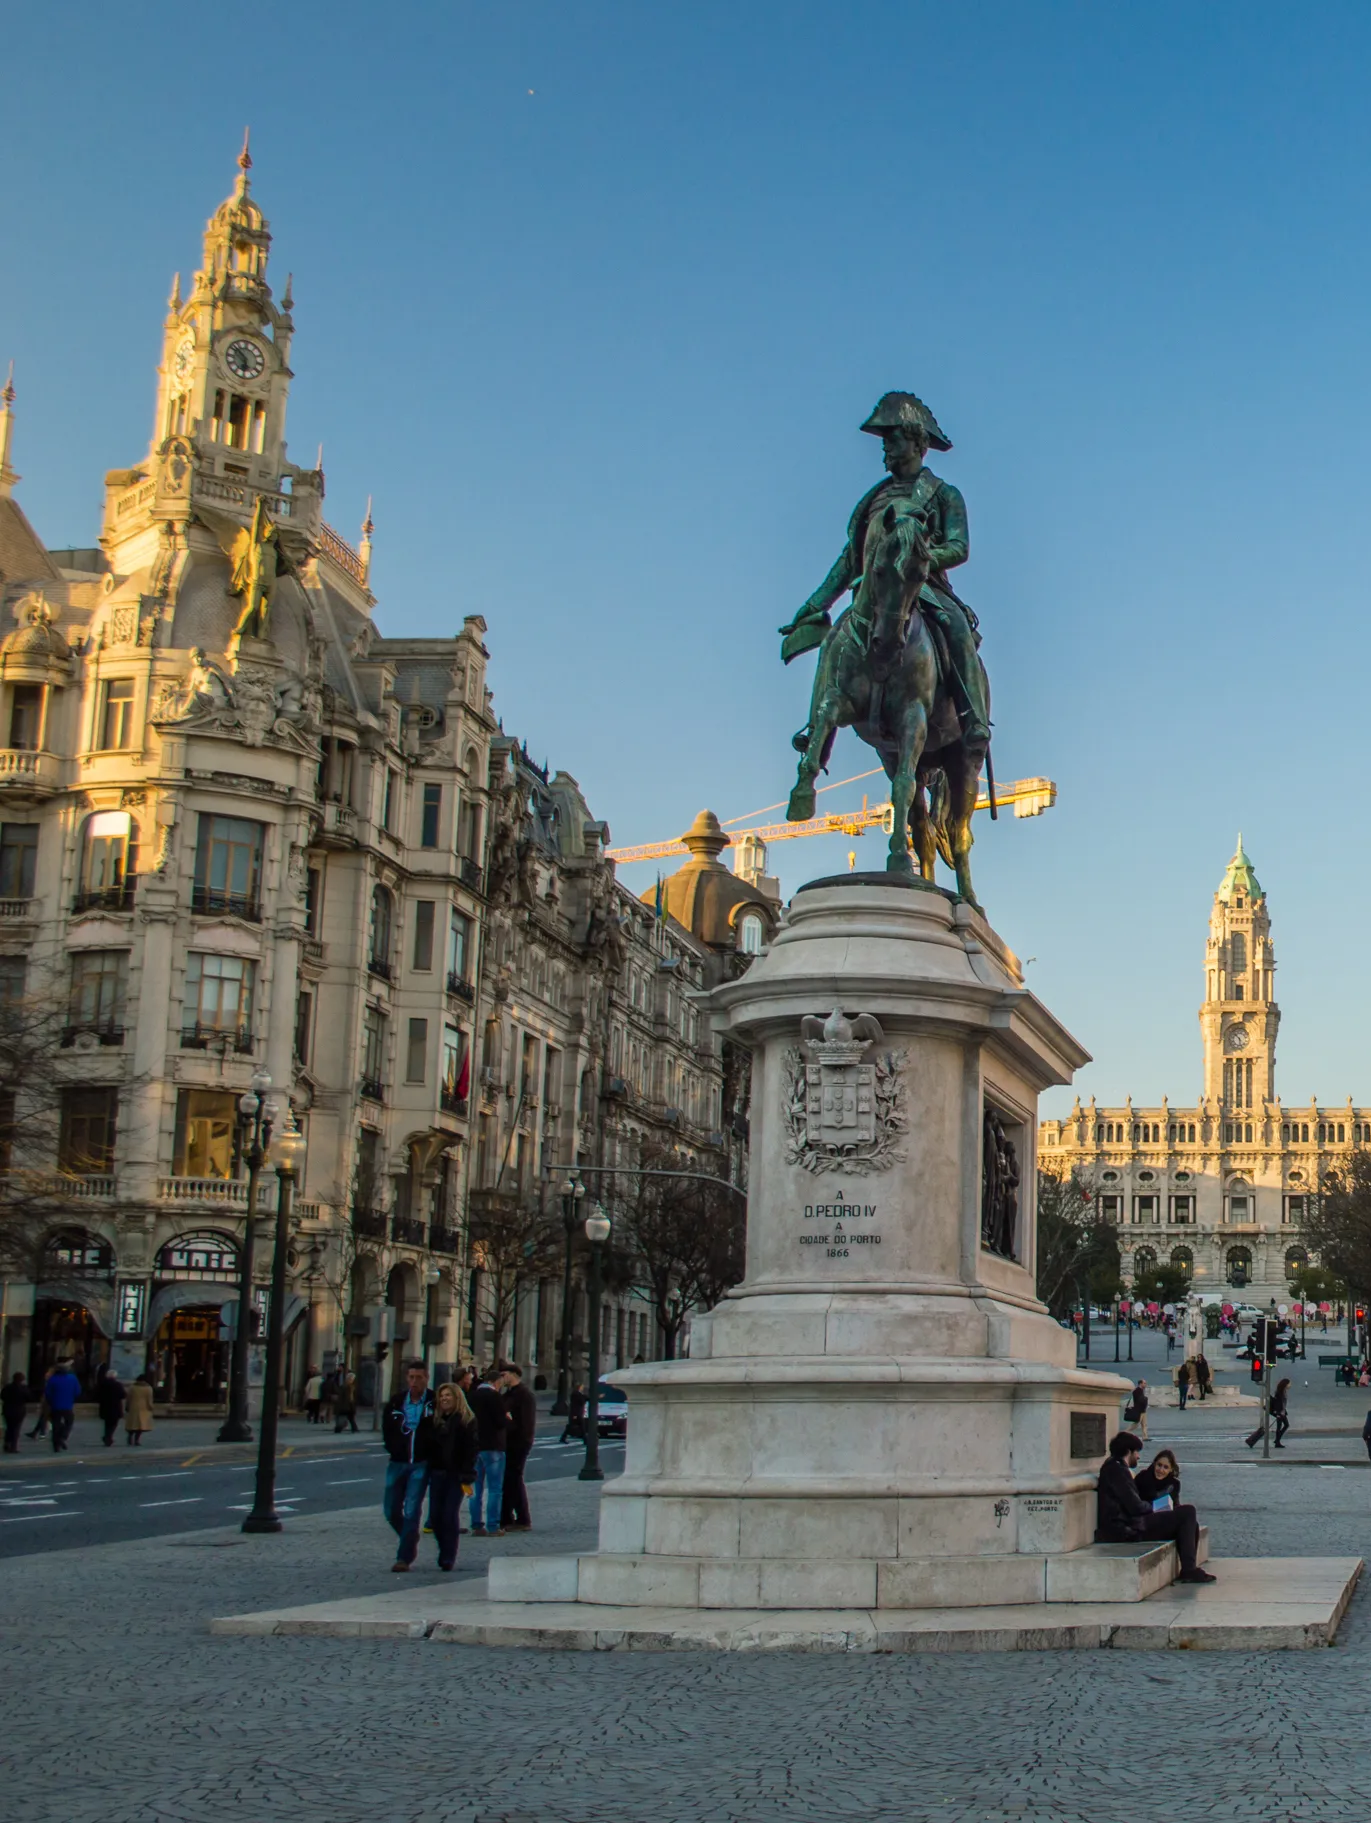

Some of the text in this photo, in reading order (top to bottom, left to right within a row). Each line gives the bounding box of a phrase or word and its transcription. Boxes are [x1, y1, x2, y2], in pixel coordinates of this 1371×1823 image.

[836, 1190, 844, 1200] A
[864, 1205, 877, 1217] IV
[835, 1222, 843, 1230] A
[799, 1235, 882, 1245] CIDADE DO PORTO
[826, 1248, 850, 1258] 1866
